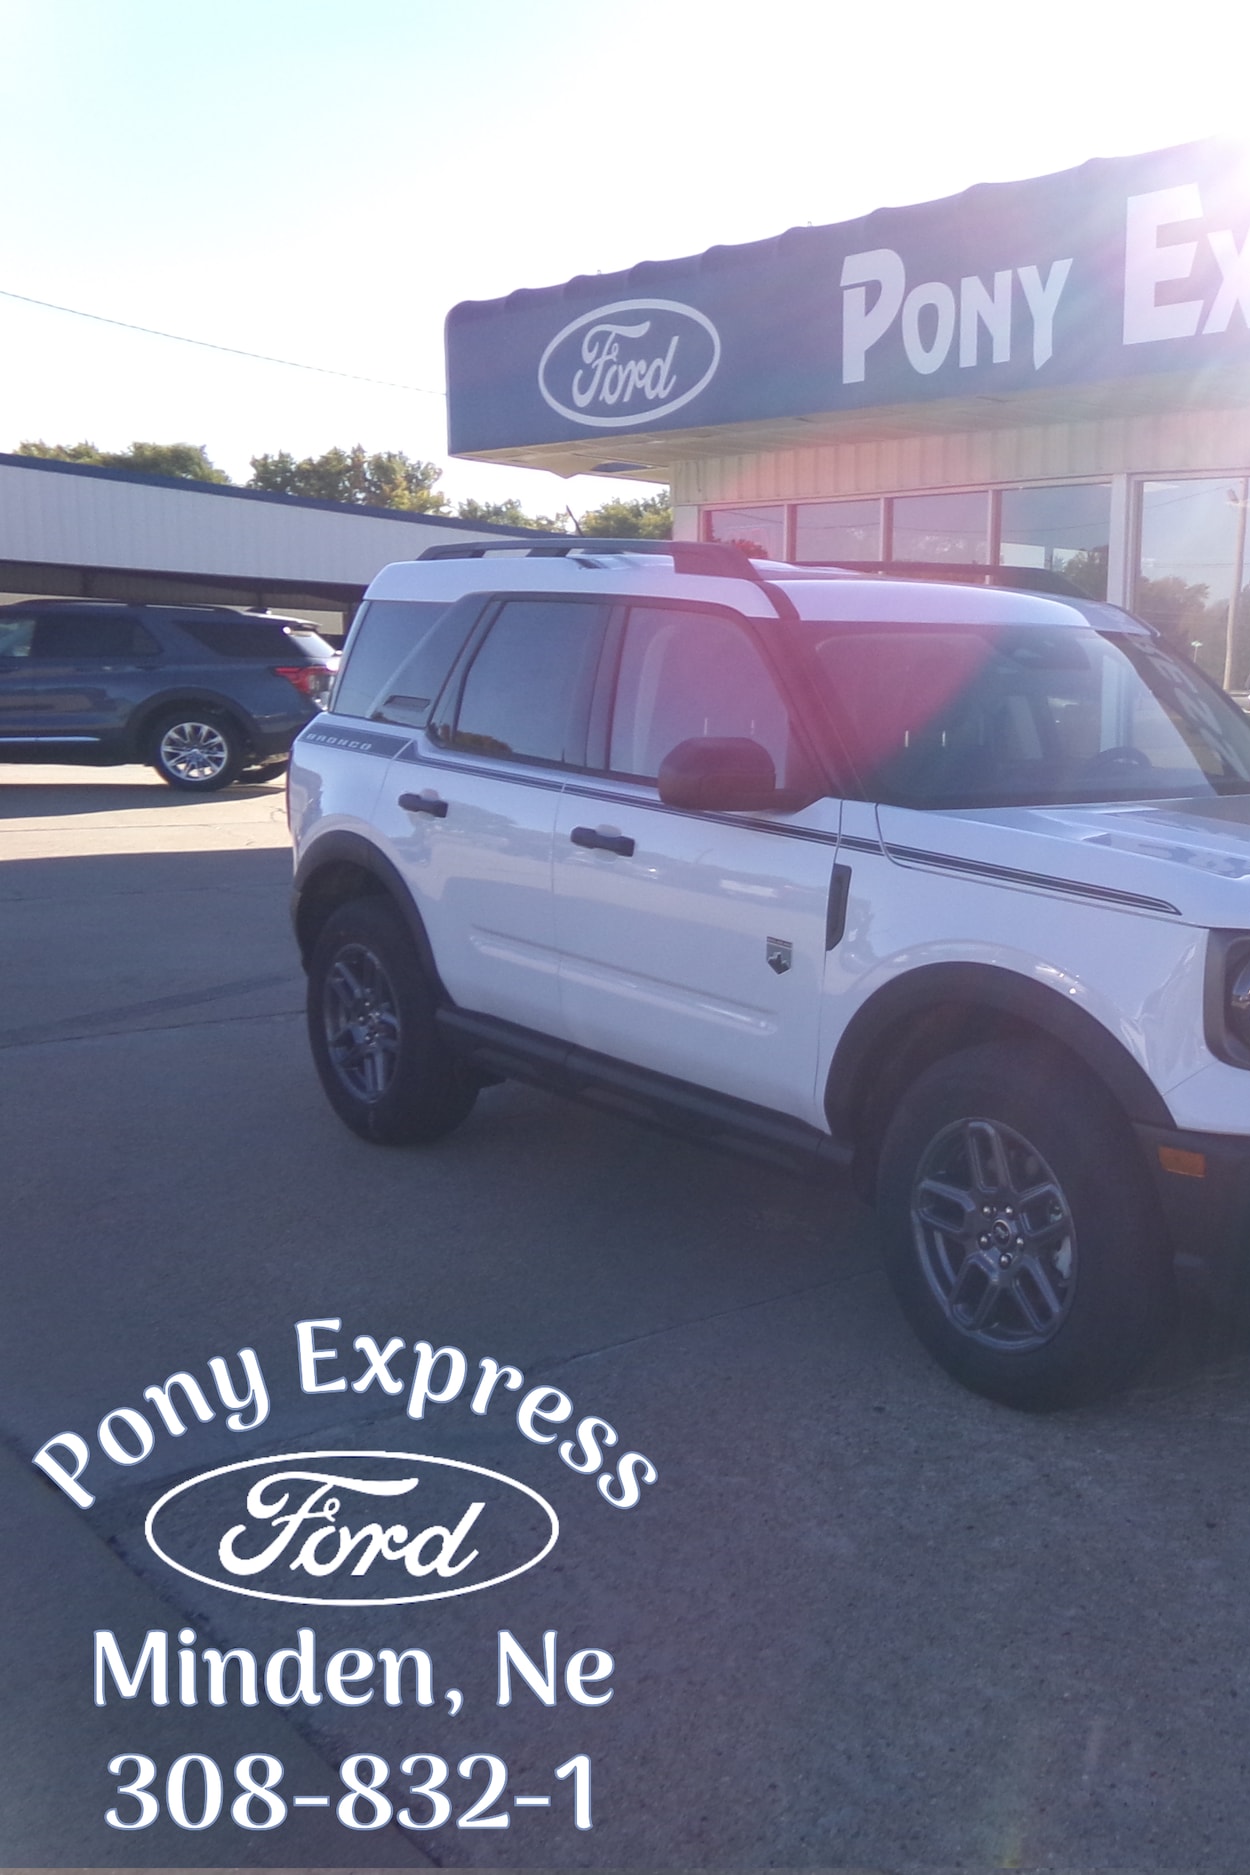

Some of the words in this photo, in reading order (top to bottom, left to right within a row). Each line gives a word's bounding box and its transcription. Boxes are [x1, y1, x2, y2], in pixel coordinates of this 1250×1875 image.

[839, 248, 1073, 384] PONY
[572, 320, 680, 408] Ford
[306, 733, 372, 751] BRONCO
